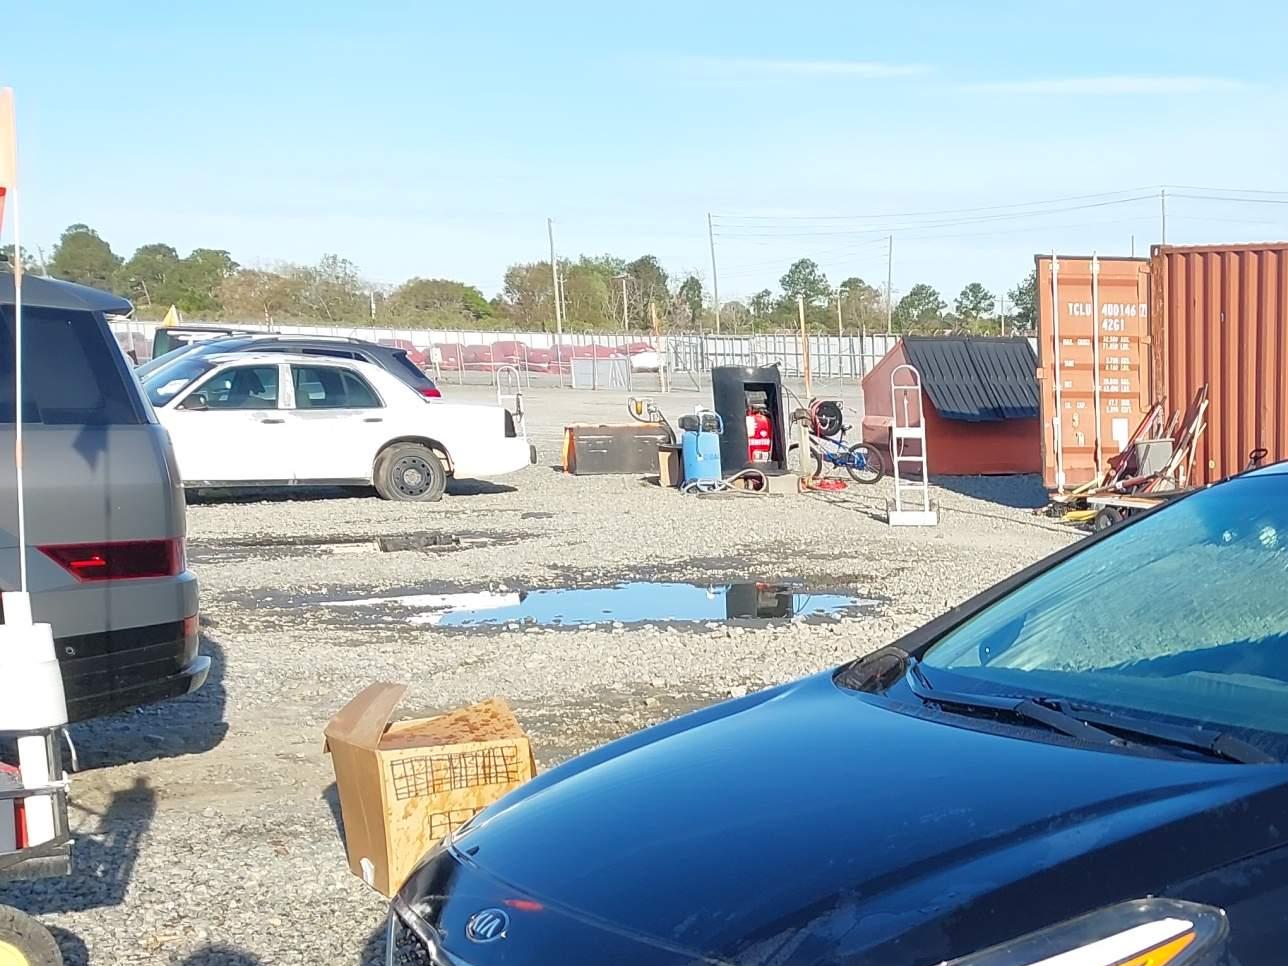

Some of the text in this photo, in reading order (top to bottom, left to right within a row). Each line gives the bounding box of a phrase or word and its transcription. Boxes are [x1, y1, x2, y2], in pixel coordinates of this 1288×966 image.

[1067, 303, 1091, 317] TCLU
[1102, 303, 1136, 317] 400146
[1102, 319, 1124, 331] 42G1
